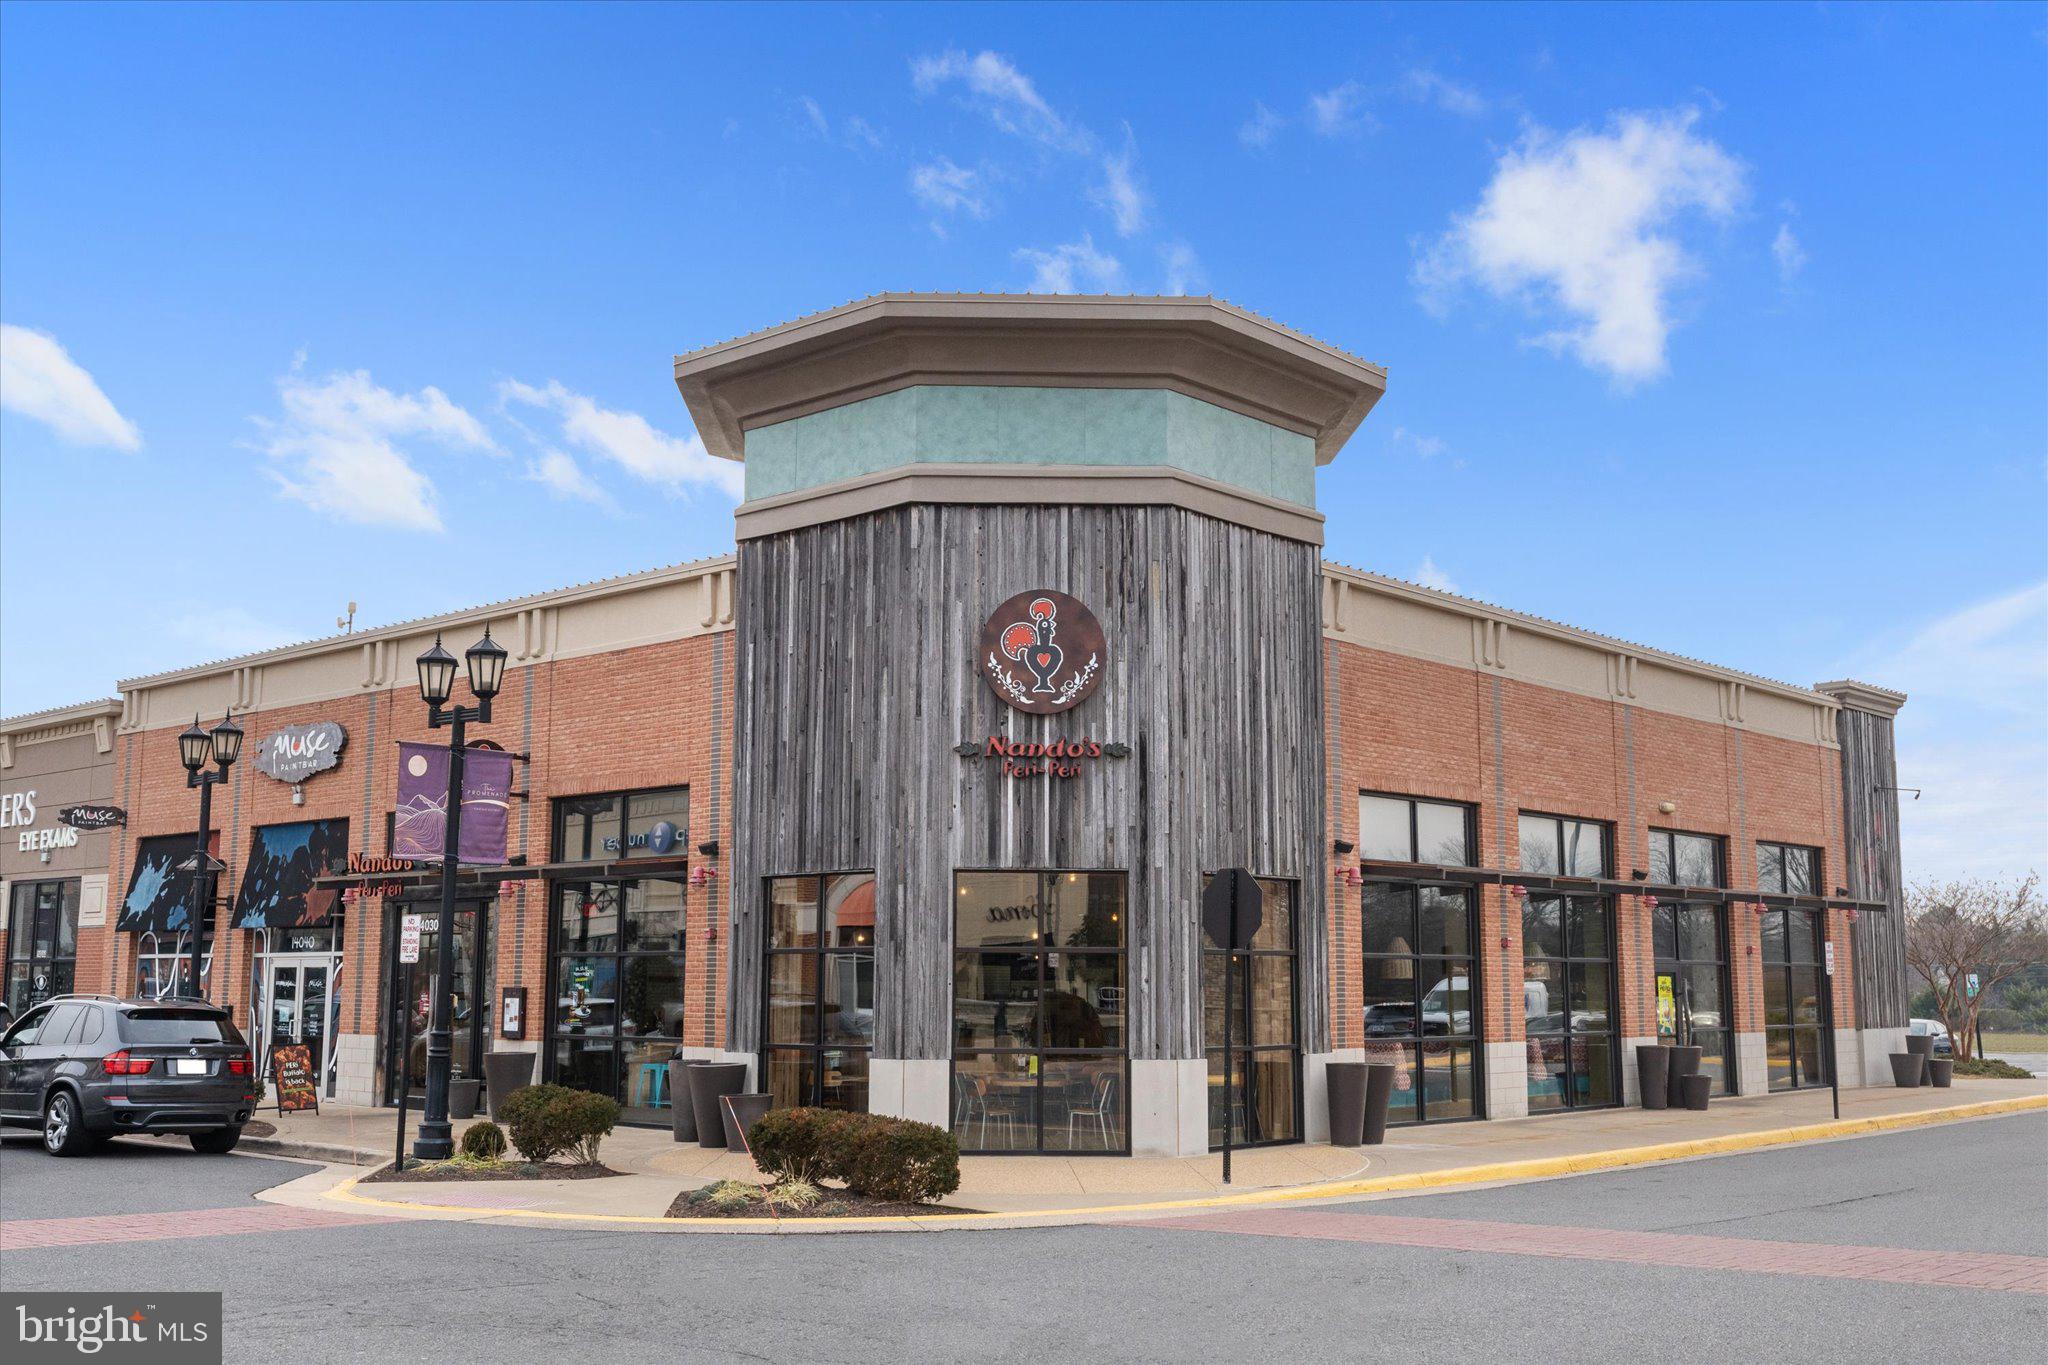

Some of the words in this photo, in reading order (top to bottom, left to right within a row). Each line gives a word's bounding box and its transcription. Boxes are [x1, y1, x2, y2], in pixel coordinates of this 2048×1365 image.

[985, 736, 1101, 758] Nando's
[281, 760, 317, 771] PAINTBAR
[1003, 761, 1081, 778] Peri-Peri
[467, 790, 508, 798] PROMENADE
[0, 791, 36, 828] ERS
[19, 831, 40, 851] EYE
[40, 827, 78, 848] EXAMS
